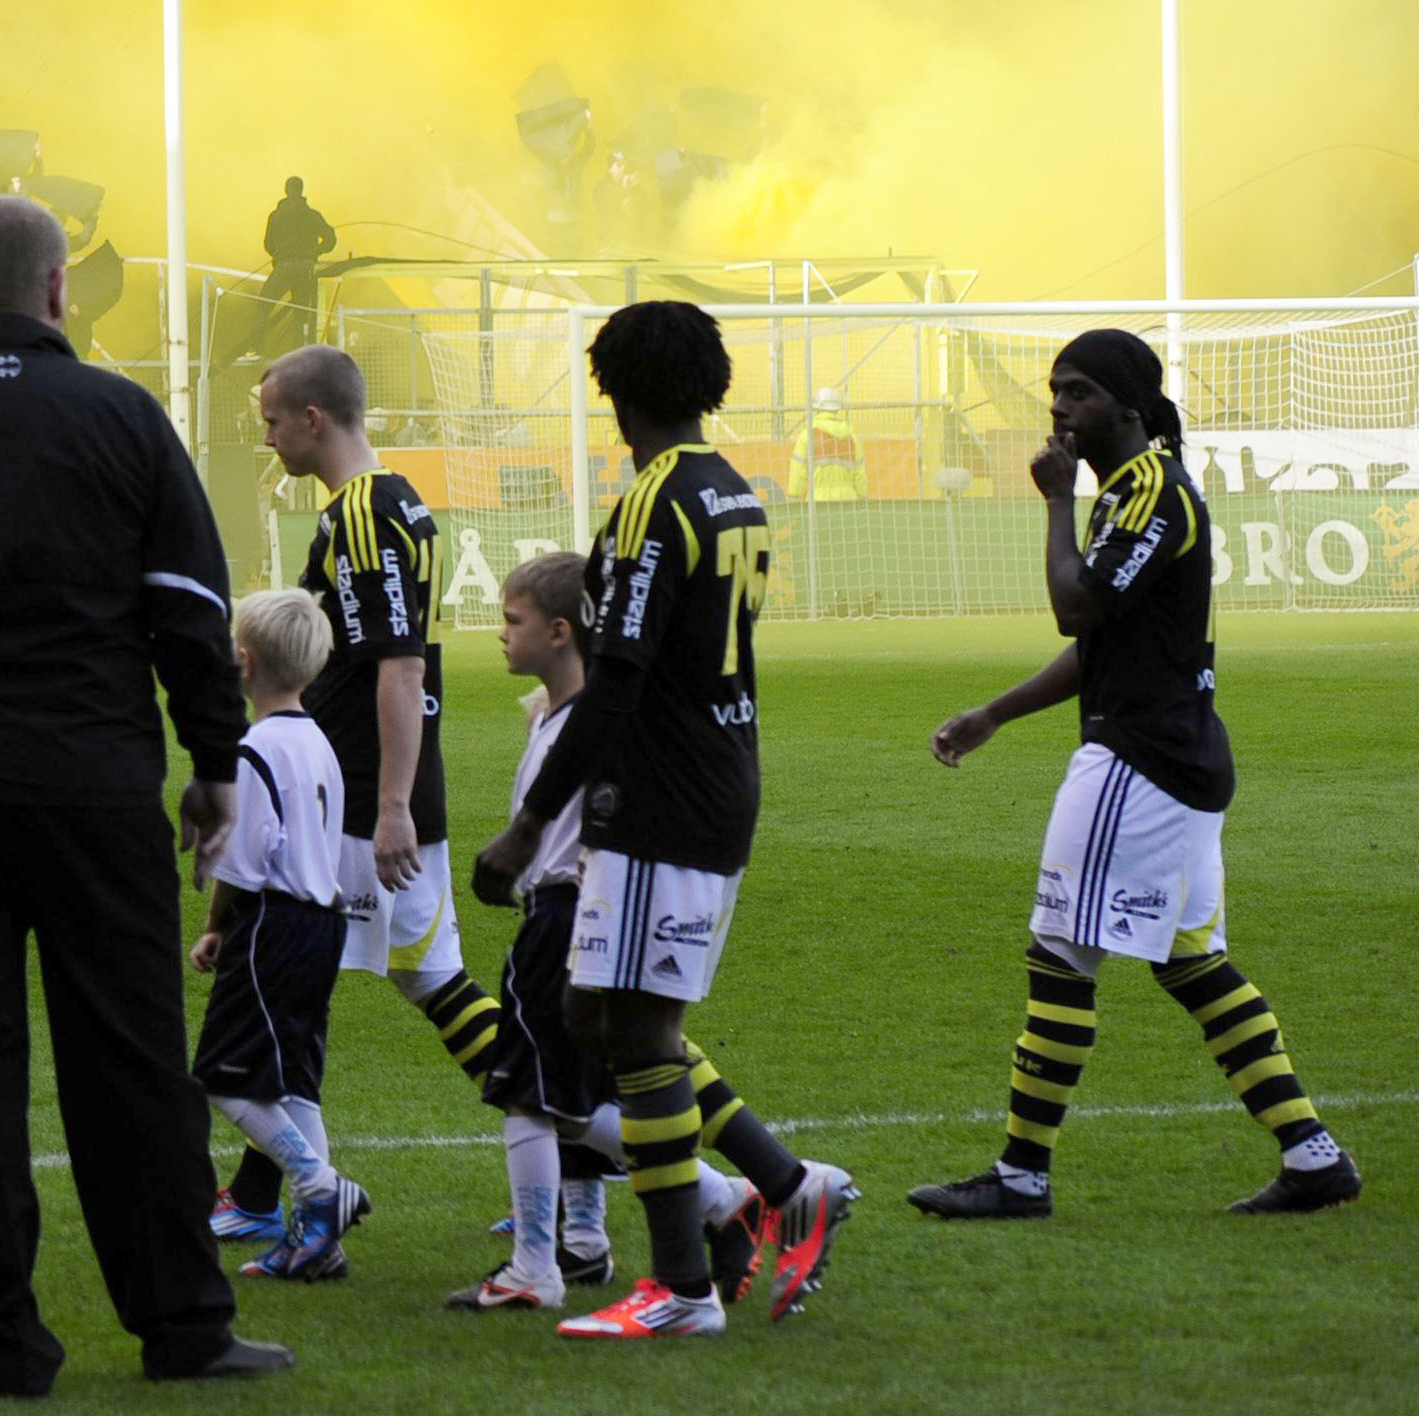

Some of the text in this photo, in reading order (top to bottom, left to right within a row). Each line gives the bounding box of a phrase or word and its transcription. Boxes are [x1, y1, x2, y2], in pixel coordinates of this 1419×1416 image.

[380, 547, 410, 637] stadium
[621, 538, 663, 640] stadium
[1112, 515, 1169, 593] stadium
[335, 554, 366, 645] stadium
